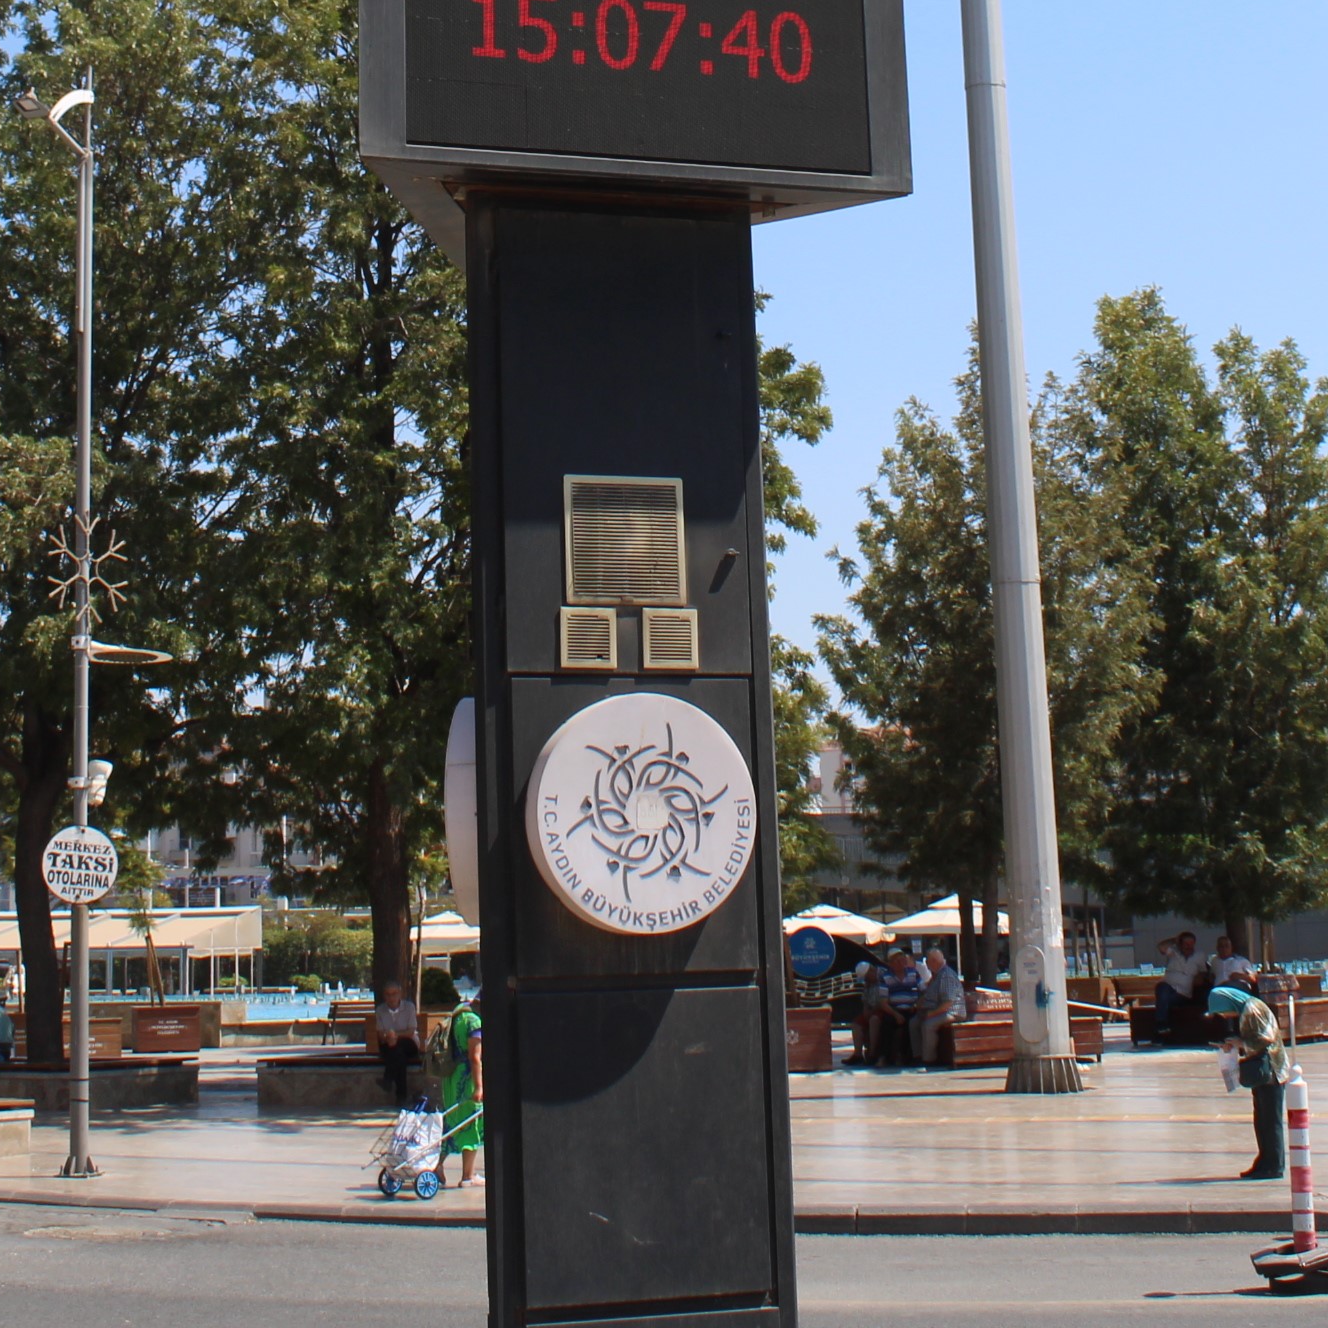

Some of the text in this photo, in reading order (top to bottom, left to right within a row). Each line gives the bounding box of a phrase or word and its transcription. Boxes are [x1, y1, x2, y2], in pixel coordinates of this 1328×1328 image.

[52, 840, 111, 855] MERKEZ
[47, 851, 114, 874] TAKSİ
[581, 888, 703, 931] BÜYÜKŞEHİR
[702, 798, 751, 905] BELEDİYESİ
[47, 870, 109, 888] OTOLARINA
